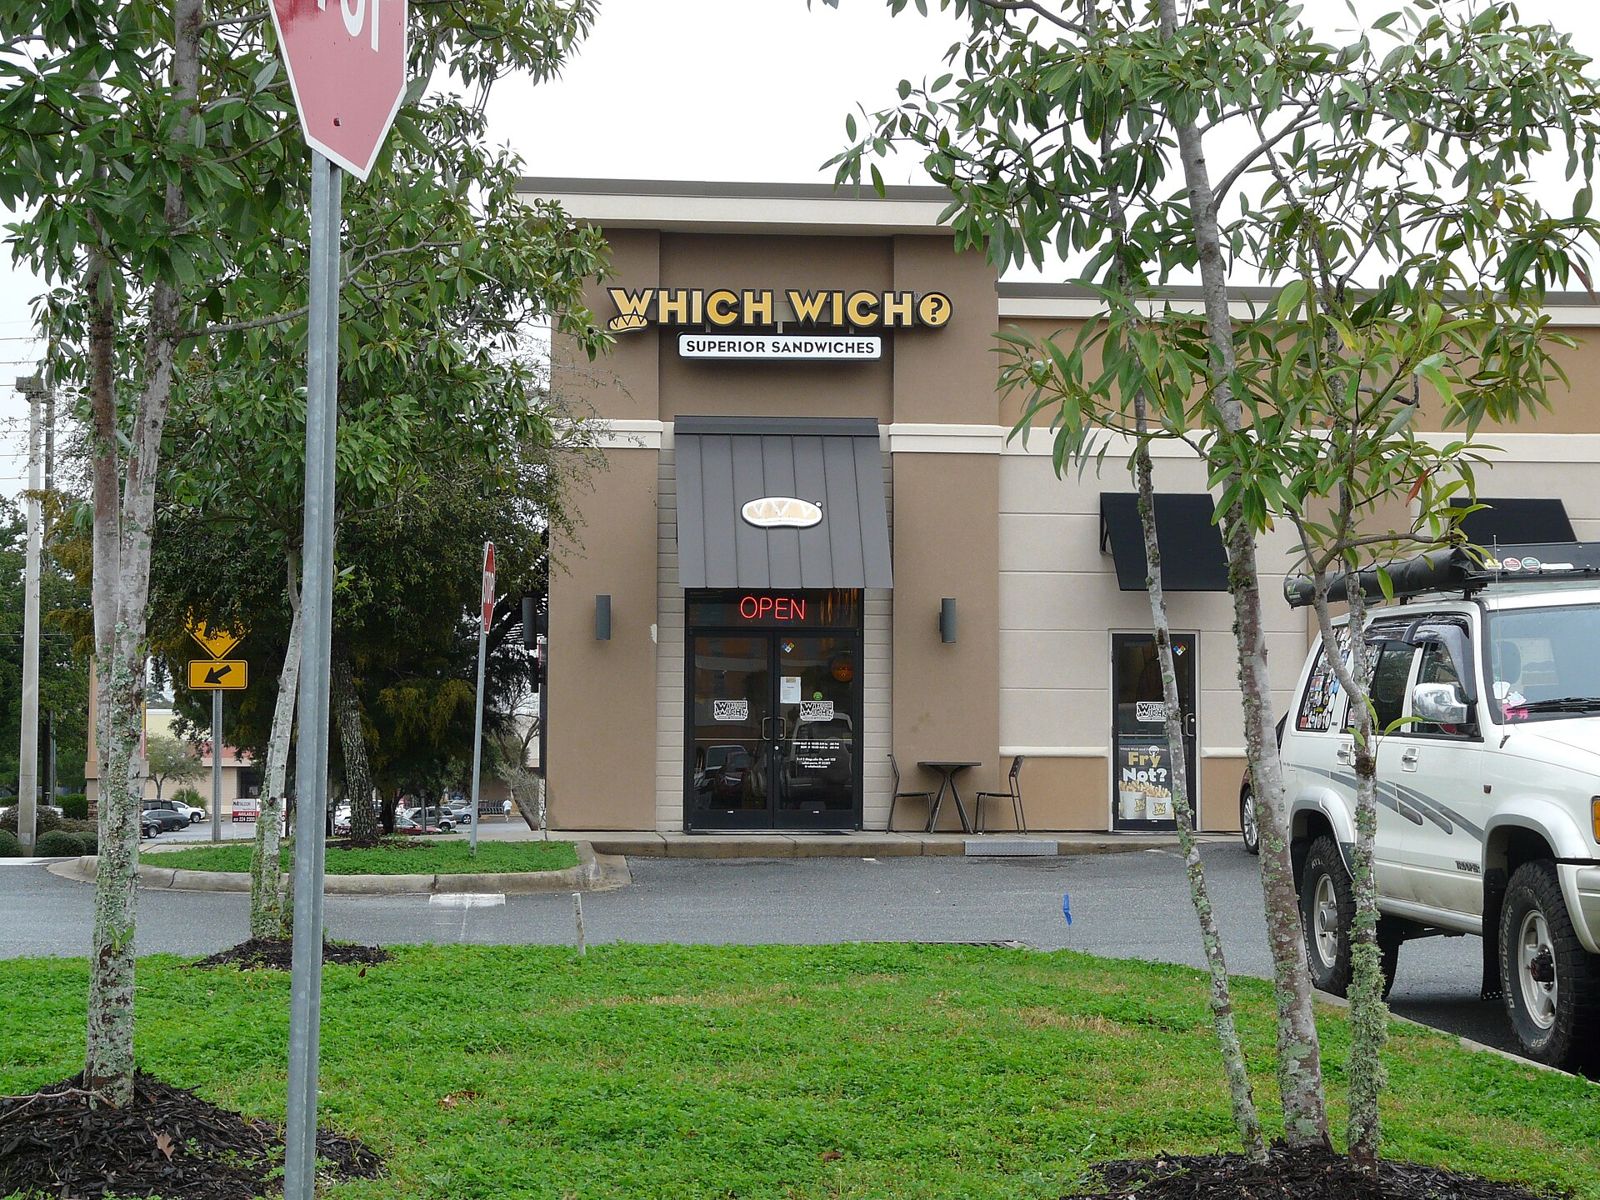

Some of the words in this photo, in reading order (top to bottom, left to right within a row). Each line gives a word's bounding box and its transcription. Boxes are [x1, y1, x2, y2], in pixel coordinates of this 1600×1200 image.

[607, 287, 774, 331] WHICH
[686, 340, 767, 353] SUPERIOR
[771, 341, 875, 354] SANDWICHES
[740, 596, 805, 620] OPEN
[1128, 751, 1161, 768] Fry
[1123, 768, 1167, 782] Not?
